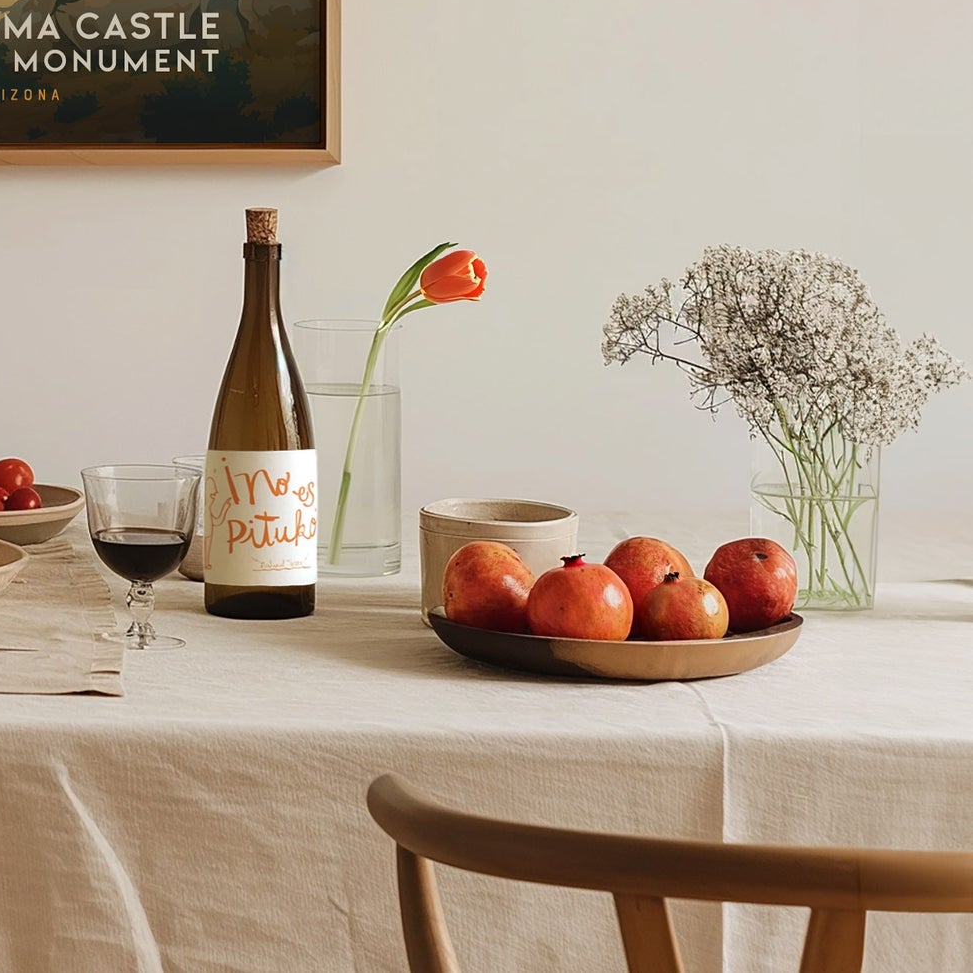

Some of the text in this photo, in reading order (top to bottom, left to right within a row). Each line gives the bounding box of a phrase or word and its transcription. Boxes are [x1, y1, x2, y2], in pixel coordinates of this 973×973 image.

[76, 11, 221, 40] CASTLE
[14, 49, 220, 73] MONUMENT
[292, 481, 315, 507] es
